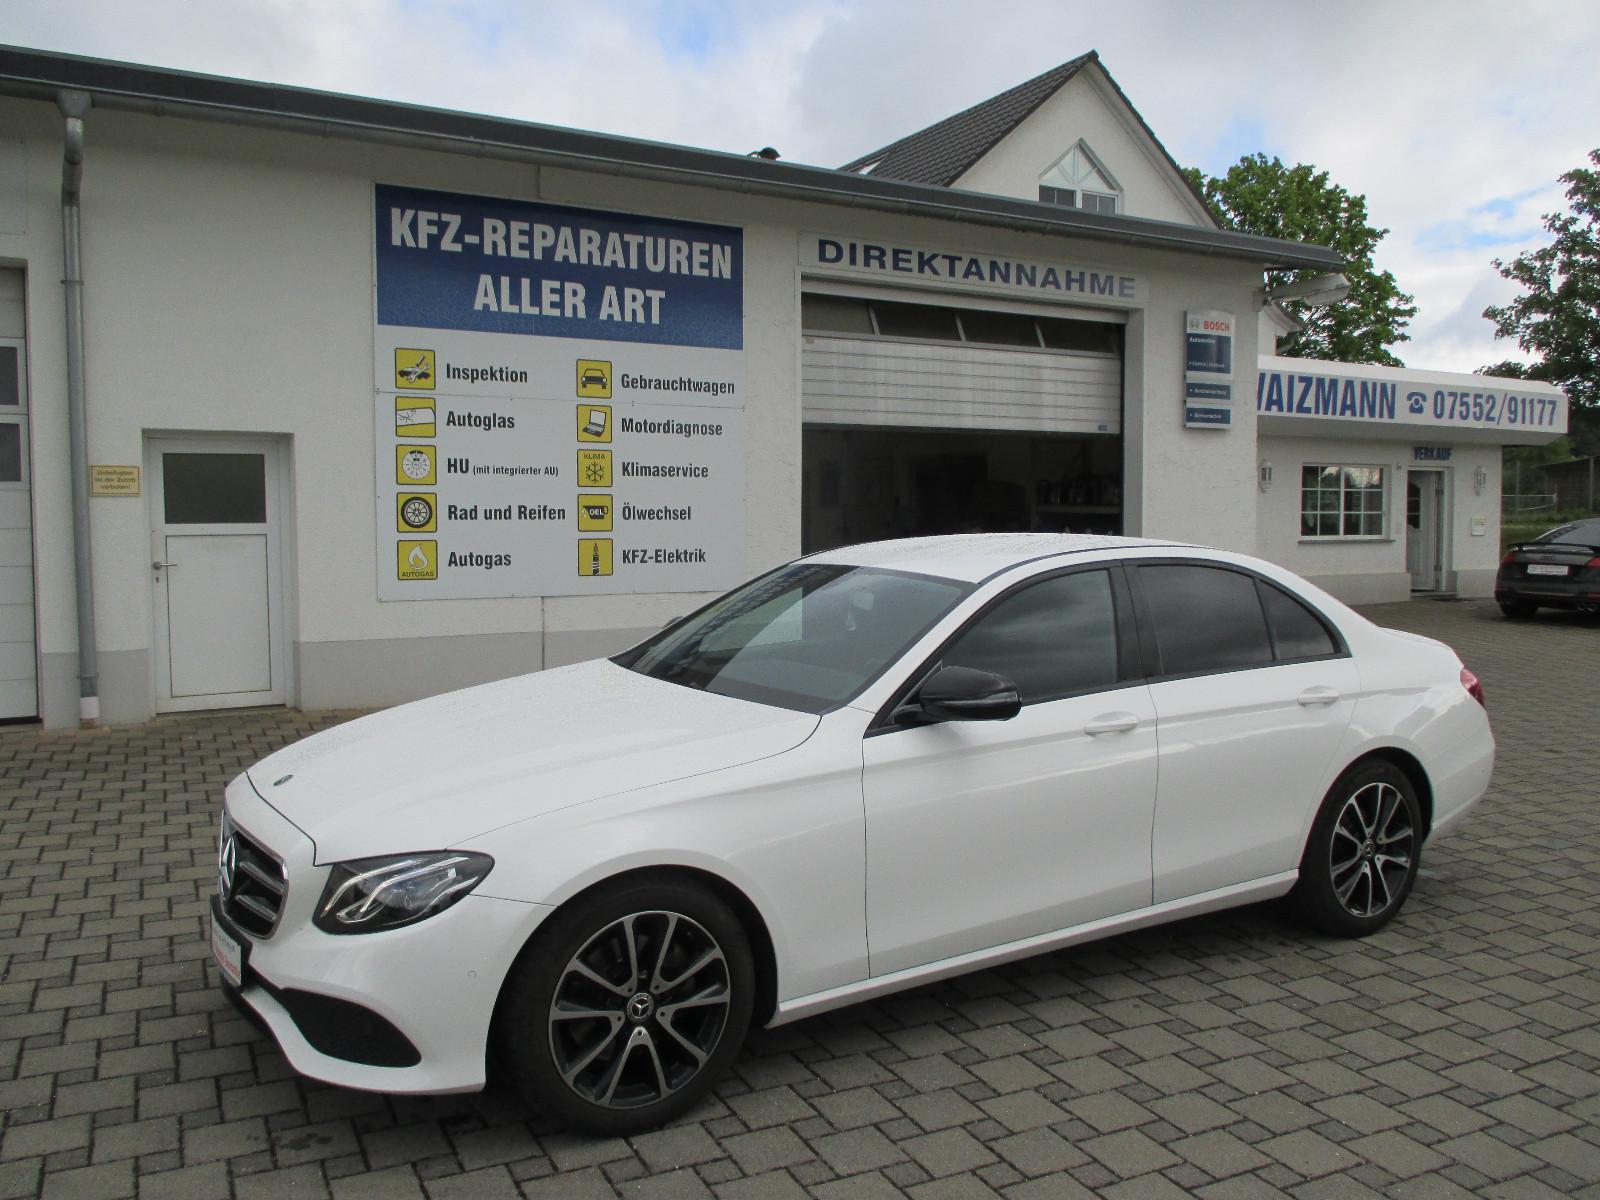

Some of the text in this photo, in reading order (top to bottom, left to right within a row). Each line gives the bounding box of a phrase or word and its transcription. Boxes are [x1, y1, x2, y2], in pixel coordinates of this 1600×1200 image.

[390, 207, 732, 279] KFZ-REPARATUREN
[818, 238, 1136, 299] DIREKTANNAHME
[473, 274, 666, 325] ALLER ART
[1203, 320, 1230, 332] BOSCH
[446, 363, 528, 385] Inspektion
[621, 374, 736, 396] Gebrauchtwagen
[1433, 389, 1558, 427] 07552/91177
[446, 411, 516, 432] Autoglas
[621, 420, 723, 438] Motordiagnose
[583, 453, 606, 461] KLIMA
[1414, 447, 1454, 461] VERKAUF
[447, 458, 559, 477] HU (mit integrierter AU)
[622, 462, 709, 479] Klimaservice
[448, 504, 566, 522] Rad und Reifen
[589, 508, 604, 516] OEL
[622, 502, 692, 521] Ölwechsel
[448, 551, 512, 571] Autogas
[622, 549, 707, 564] KFZ-Elektrik
[401, 570, 435, 578] AUTOGAS
